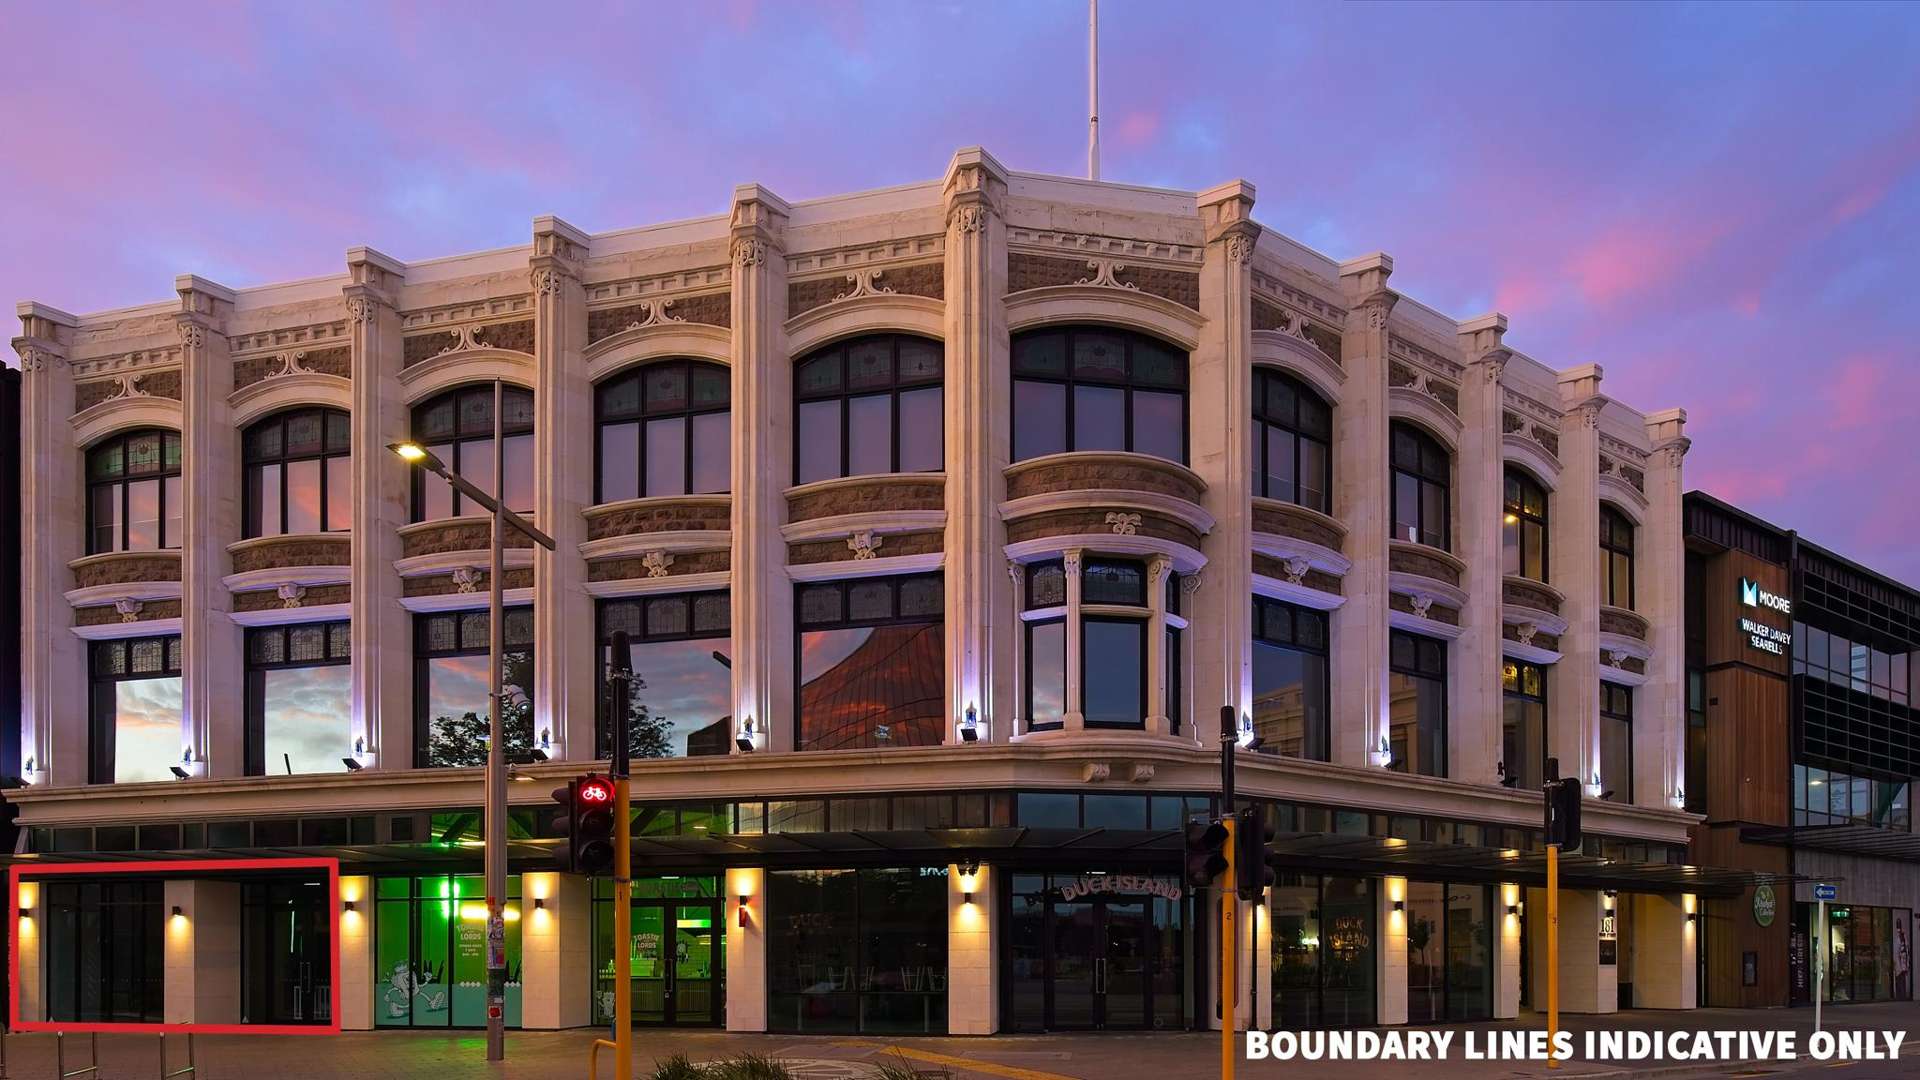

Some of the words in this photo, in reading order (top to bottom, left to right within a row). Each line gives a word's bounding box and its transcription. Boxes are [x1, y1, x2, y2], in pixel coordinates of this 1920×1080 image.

[1759, 590, 1791, 614] MOORE
[1742, 618, 1769, 637] WALKER
[1770, 629, 1792, 645] DAVEY
[1751, 635, 1783, 655] SEARELLS
[1061, 876, 1116, 902] DUCK
[1116, 876, 1182, 901] ISLAND
[1601, 918, 1614, 933] 181
